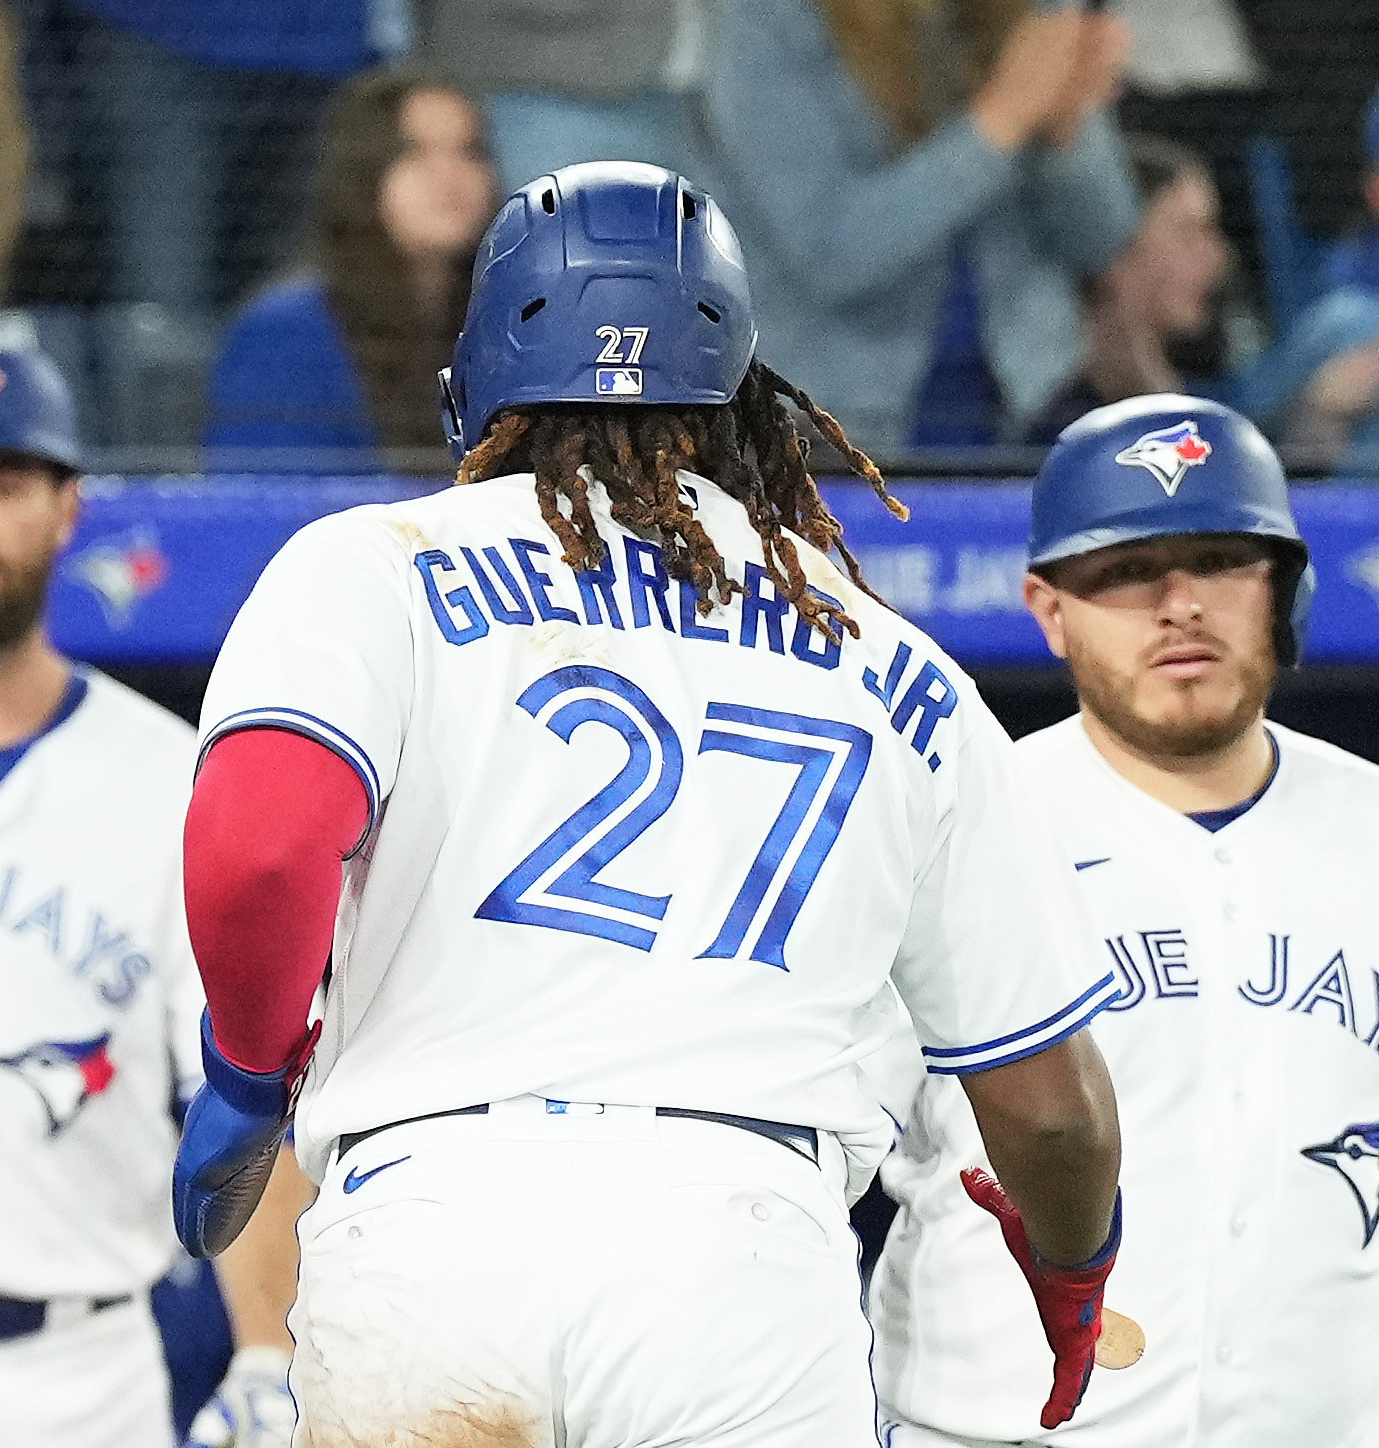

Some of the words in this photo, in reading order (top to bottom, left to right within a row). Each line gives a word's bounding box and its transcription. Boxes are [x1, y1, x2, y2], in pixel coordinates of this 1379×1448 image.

[594, 324, 650, 365] 27
[861, 640, 959, 774] JR.
[473, 663, 875, 973] 27
